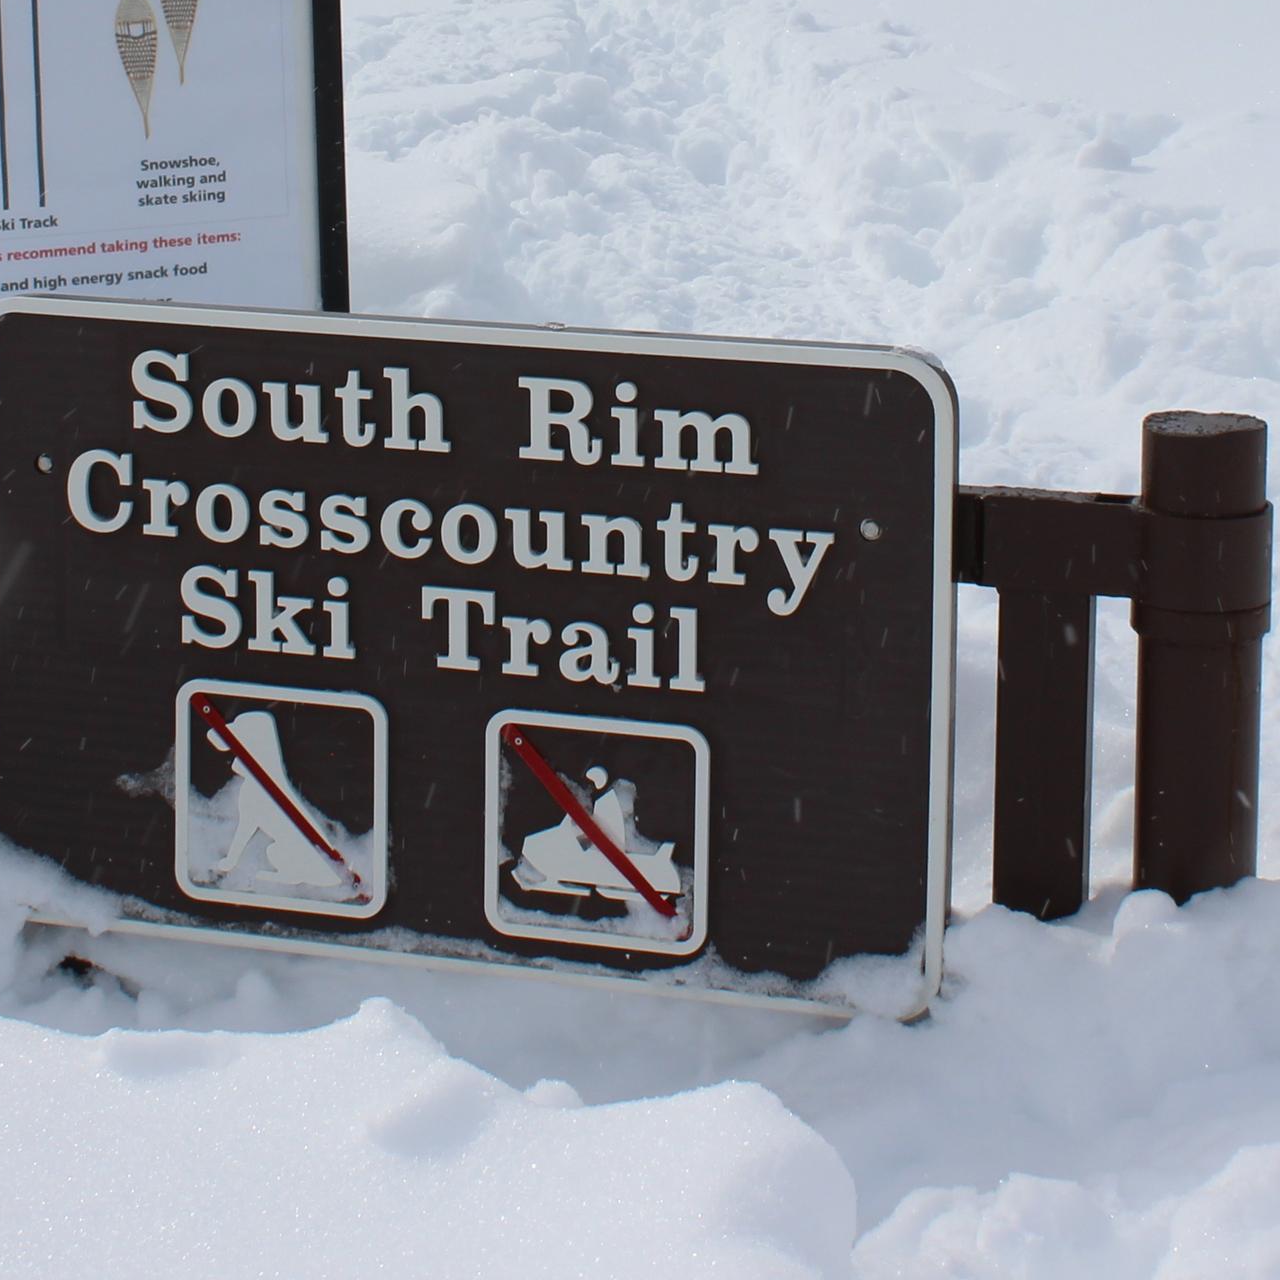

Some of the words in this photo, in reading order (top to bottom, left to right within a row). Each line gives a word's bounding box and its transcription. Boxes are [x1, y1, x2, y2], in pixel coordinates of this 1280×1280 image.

[140, 155, 221, 171] Snowshoe,
[135, 173, 196, 190] walking
[199, 170, 227, 185] and
[137, 191, 178, 207] skate
[181, 189, 226, 204] skiing
[18, 215, 59, 230] Track
[7, 241, 96, 262] recommend
[100, 238, 149, 254] taking
[152, 234, 193, 249] these
[196, 231, 242, 245] items:
[0, 277, 29, 293] and
[33, 273, 67, 292] high
[71, 271, 124, 288] energy
[127, 266, 169, 281] snack
[172, 262, 208, 277] food
[130, 348, 451, 454] South
[517, 375, 760, 476] Rim
[66, 447, 835, 616] Crosscountry
[178, 564, 357, 660] Ski
[420, 583, 706, 692] Trail
